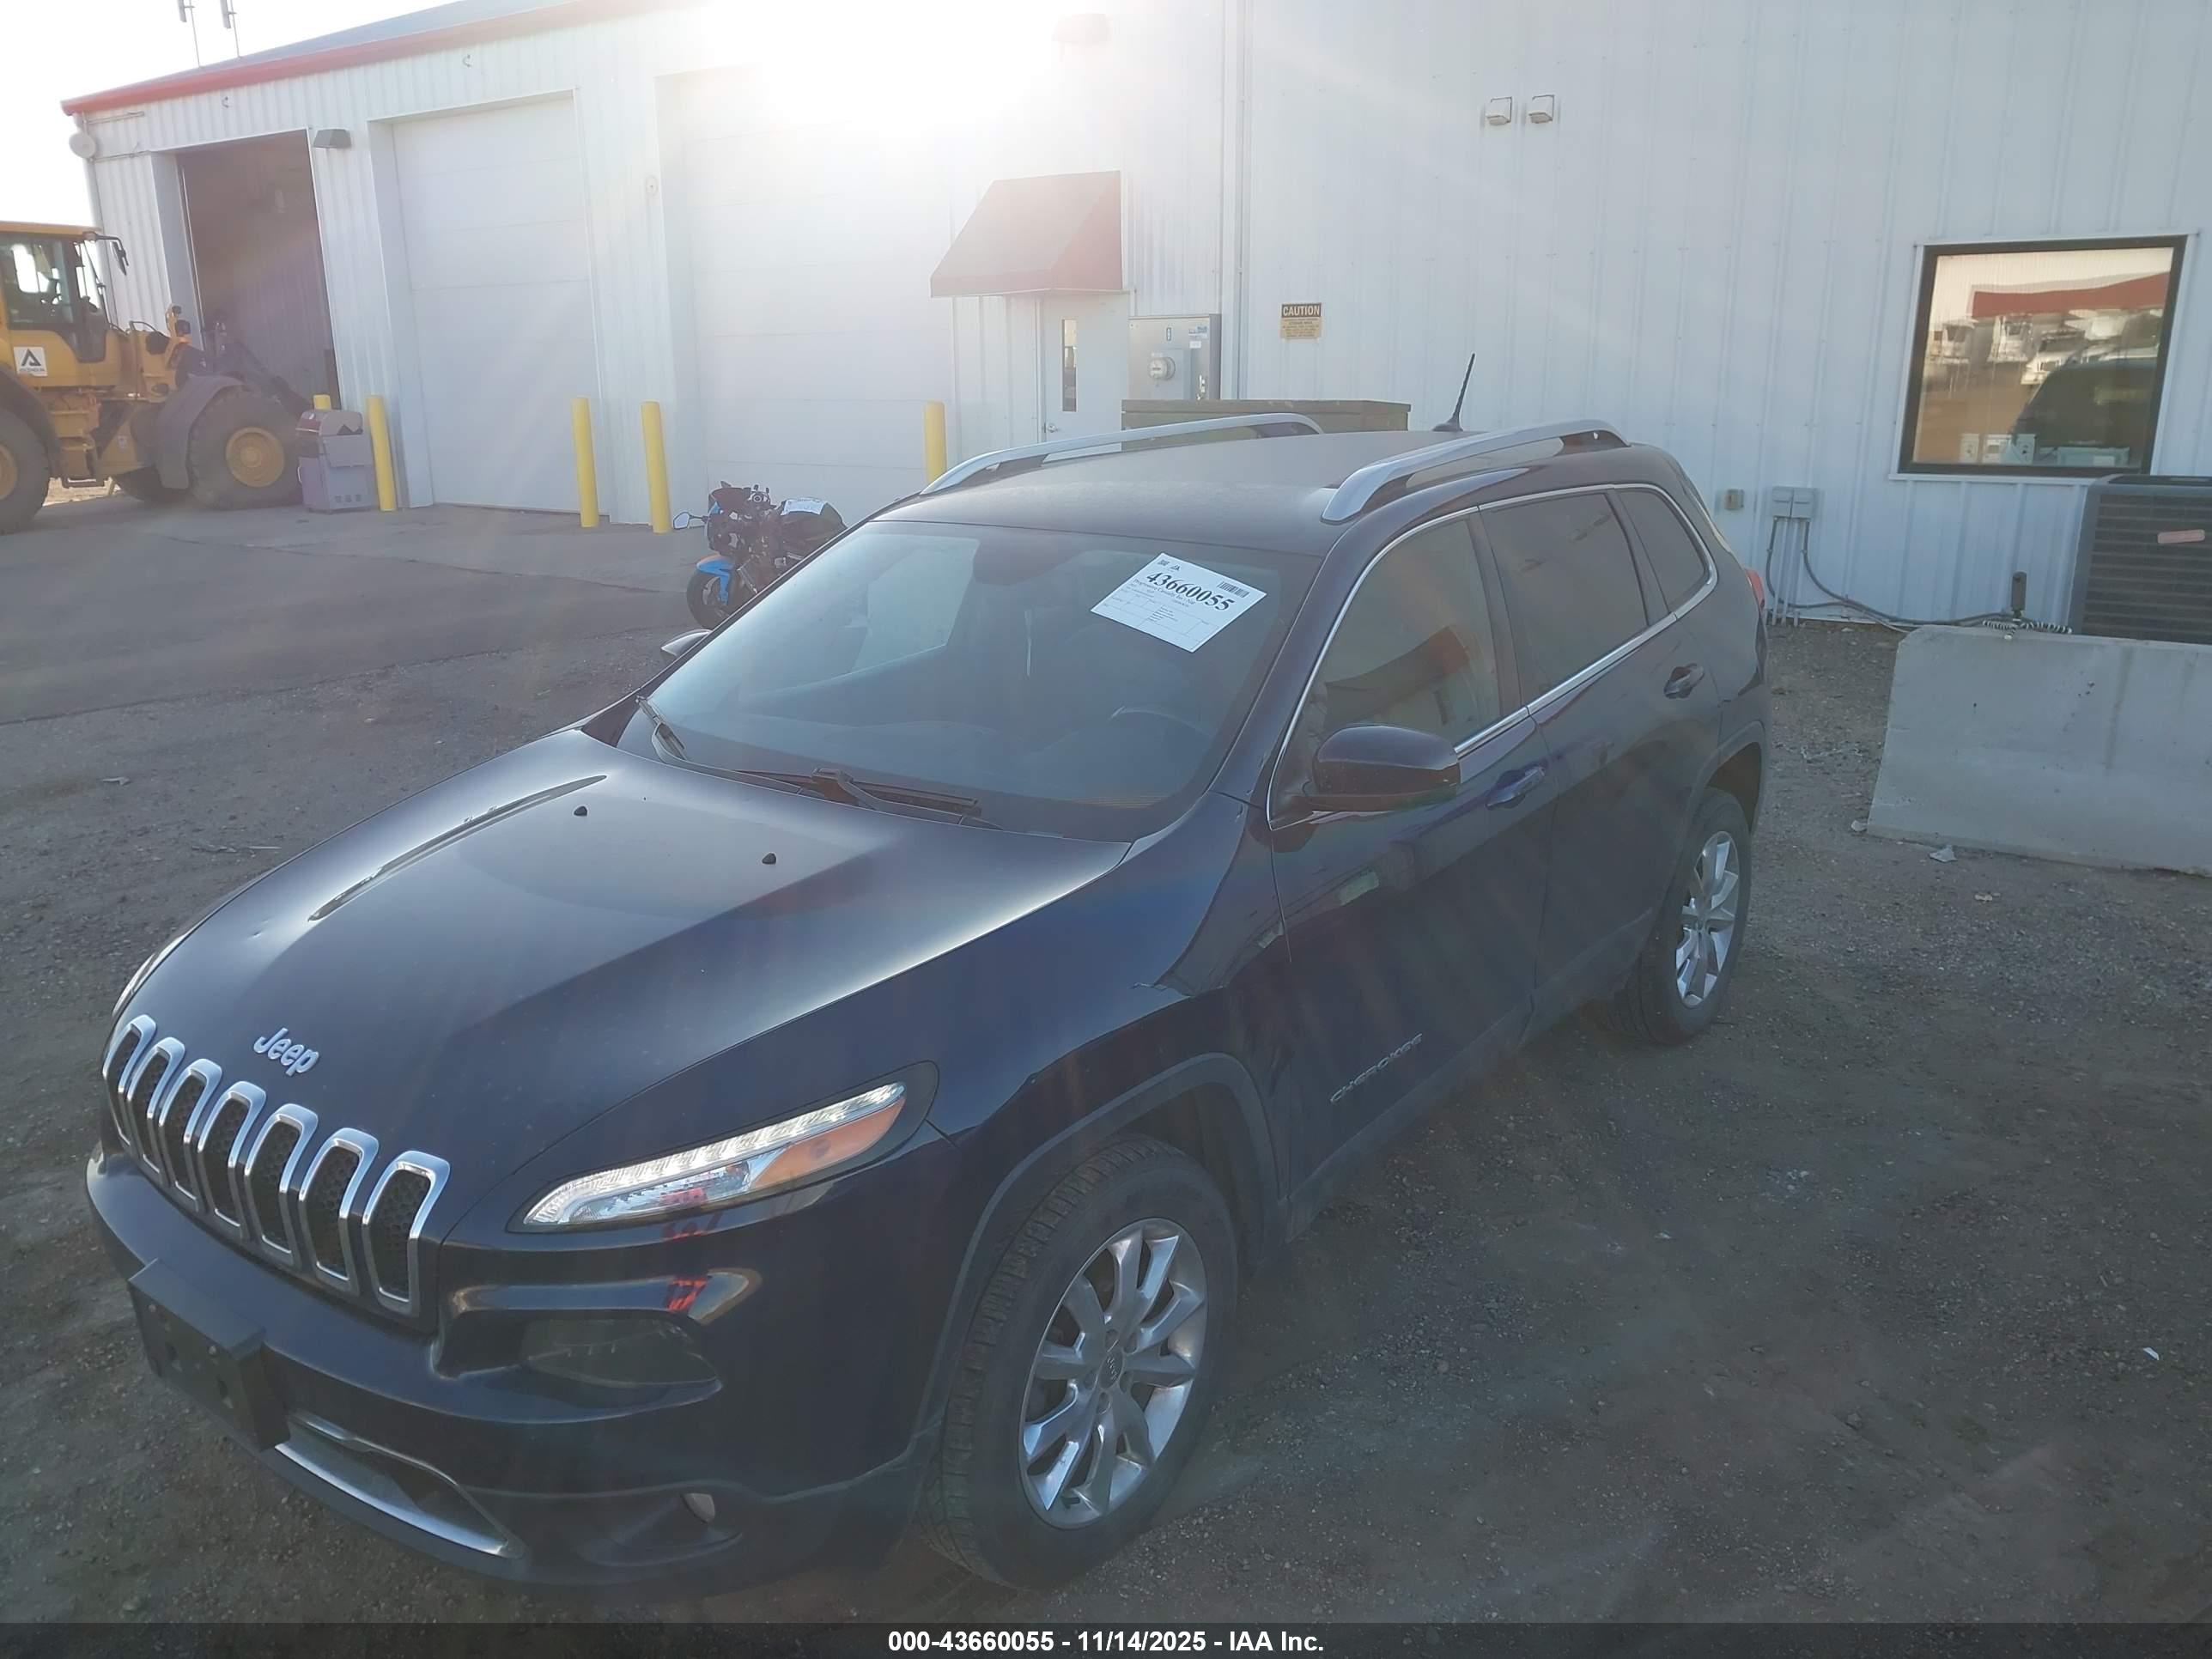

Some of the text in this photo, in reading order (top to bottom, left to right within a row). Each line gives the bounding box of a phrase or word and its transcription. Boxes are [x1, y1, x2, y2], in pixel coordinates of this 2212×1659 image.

[1283, 306, 1320, 316] CAUTION
[1146, 572, 1235, 611] 43660055
[253, 1027, 319, 1076] Jeep
[1330, 1033, 1422, 1102] CHEROKEE
